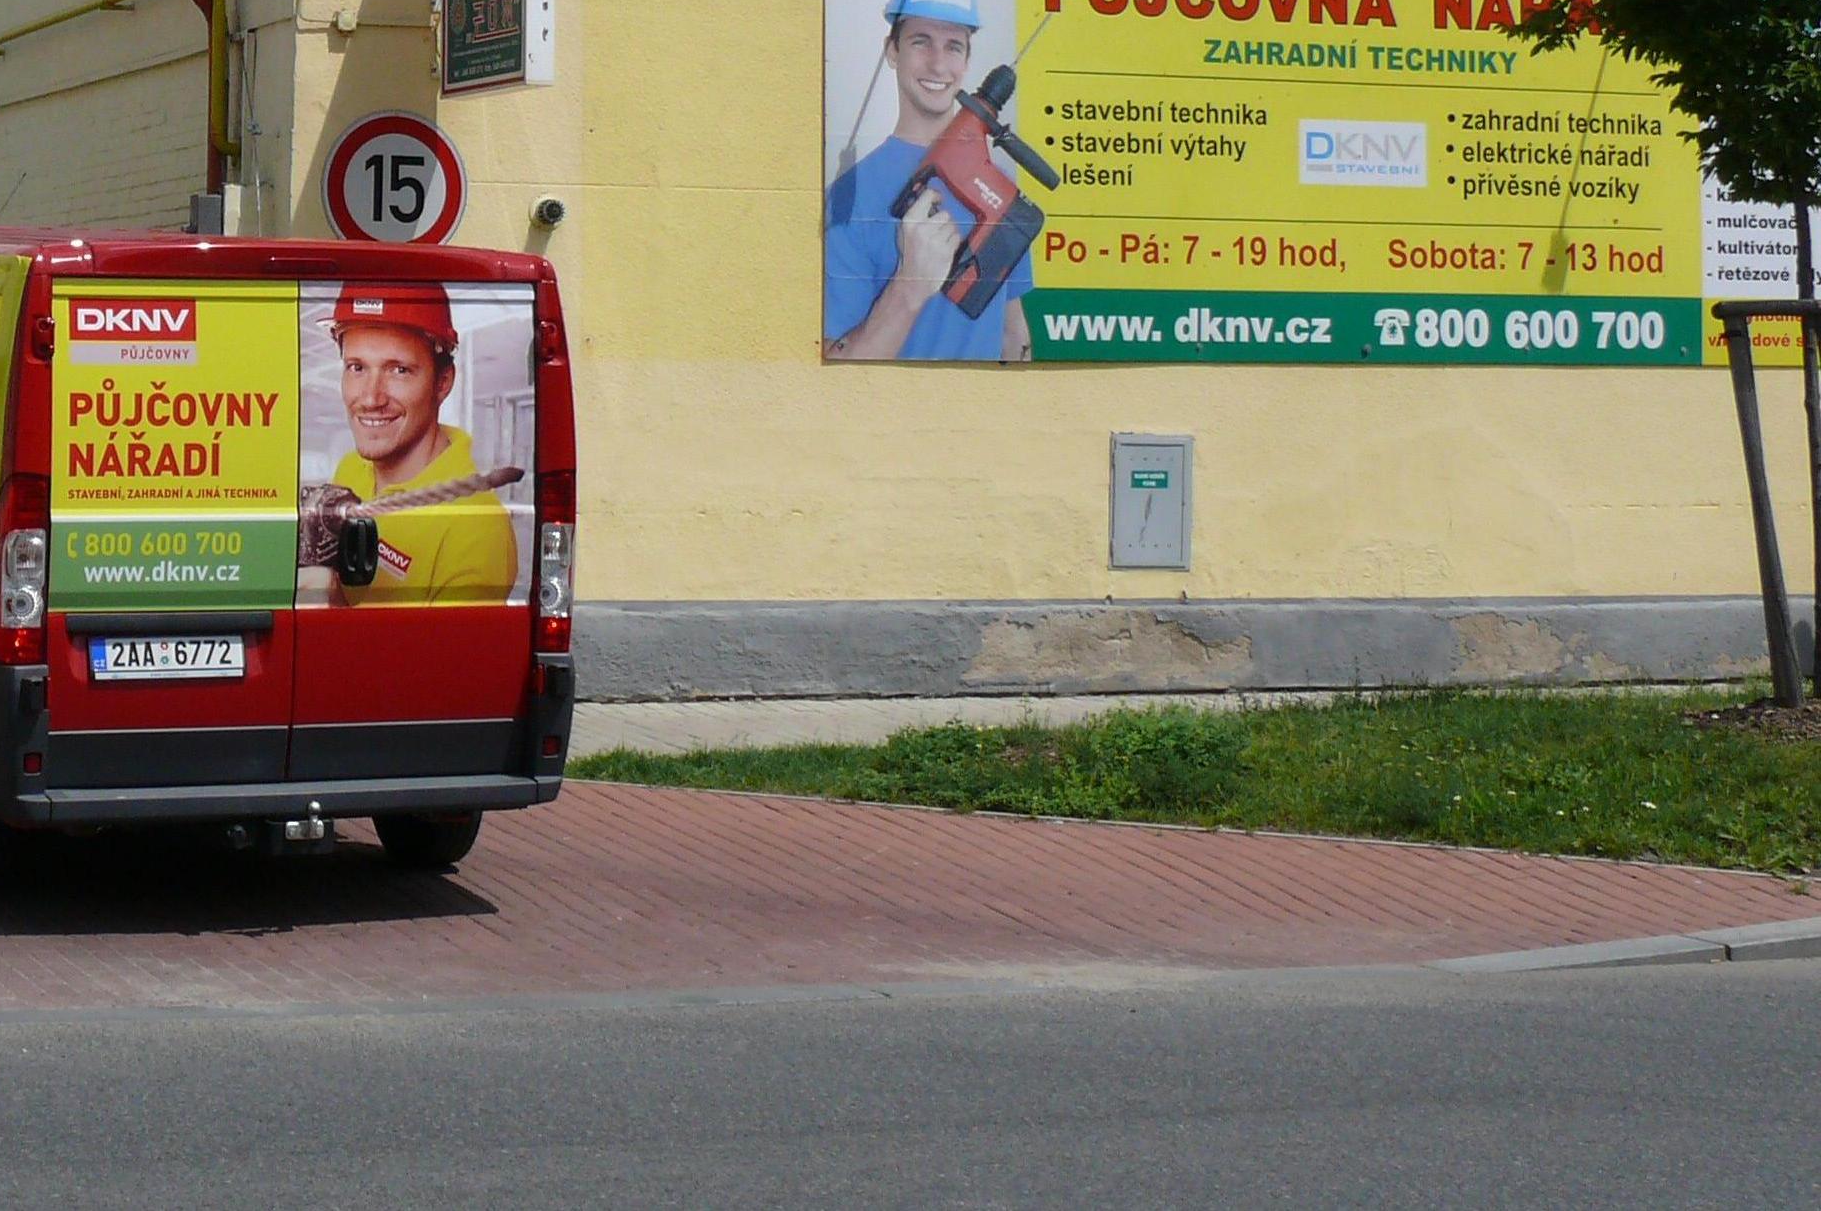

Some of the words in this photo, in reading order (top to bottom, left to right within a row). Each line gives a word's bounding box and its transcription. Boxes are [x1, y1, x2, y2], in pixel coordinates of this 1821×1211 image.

[1203, 39, 1357, 69] ZAHRADNÍ
[1367, 45, 1517, 74] TECHNIKY
[1061, 100, 1165, 122] stavební
[1170, 103, 1268, 126] technika
[1461, 109, 1560, 133] zahradní
[1568, 112, 1662, 136] technika
[1061, 132, 1165, 154] stavební
[1170, 133, 1247, 162] výtahy
[1306, 132, 1418, 162] DKNV
[1462, 142, 1572, 165] elektrické
[1580, 145, 1650, 167] nářadí
[365, 154, 425, 223] 15
[1062, 163, 1133, 187] lešení
[1463, 173, 1561, 200] přívěsné
[1569, 175, 1640, 204] vozíky
[1045, 232, 1087, 263] Po
[1120, 234, 1169, 264] Pá:
[1182, 235, 1200, 265] 7
[1232, 237, 1267, 266] 19
[1279, 237, 1346, 273] hod,
[1388, 239, 1505, 270] Sobota:
[1517, 242, 1534, 270] 7
[1565, 243, 1597, 272] 13
[1608, 245, 1664, 273] hod
[1717, 267, 1790, 281] řetězové
[77, 308, 189, 331] DKNV
[1044, 314, 1162, 342] www.
[1174, 308, 1332, 343] dknv.cz
[1415, 308, 1489, 348] 800
[1505, 310, 1579, 349] 600
[1591, 311, 1664, 350] 700
[120, 345, 190, 360] PŮJČOVNY
[69, 378, 279, 427] PŮJČOVNY
[68, 431, 222, 477] NÁŘADÍ
[68, 486, 125, 500] STAVEBNÍ,
[127, 486, 183, 498] ZAHRADNÍ
[186, 488, 193, 498] A
[196, 486, 220, 498] JINÁ
[224, 488, 278, 499] TECHNIKA
[84, 532, 131, 556] 800
[140, 532, 187, 556] 600
[196, 531, 242, 555] 700
[378, 542, 410, 568] DKNV
[84, 560, 240, 582] www.dknv.cz
[112, 642, 155, 667] 2AA
[174, 640, 232, 665] 6772
